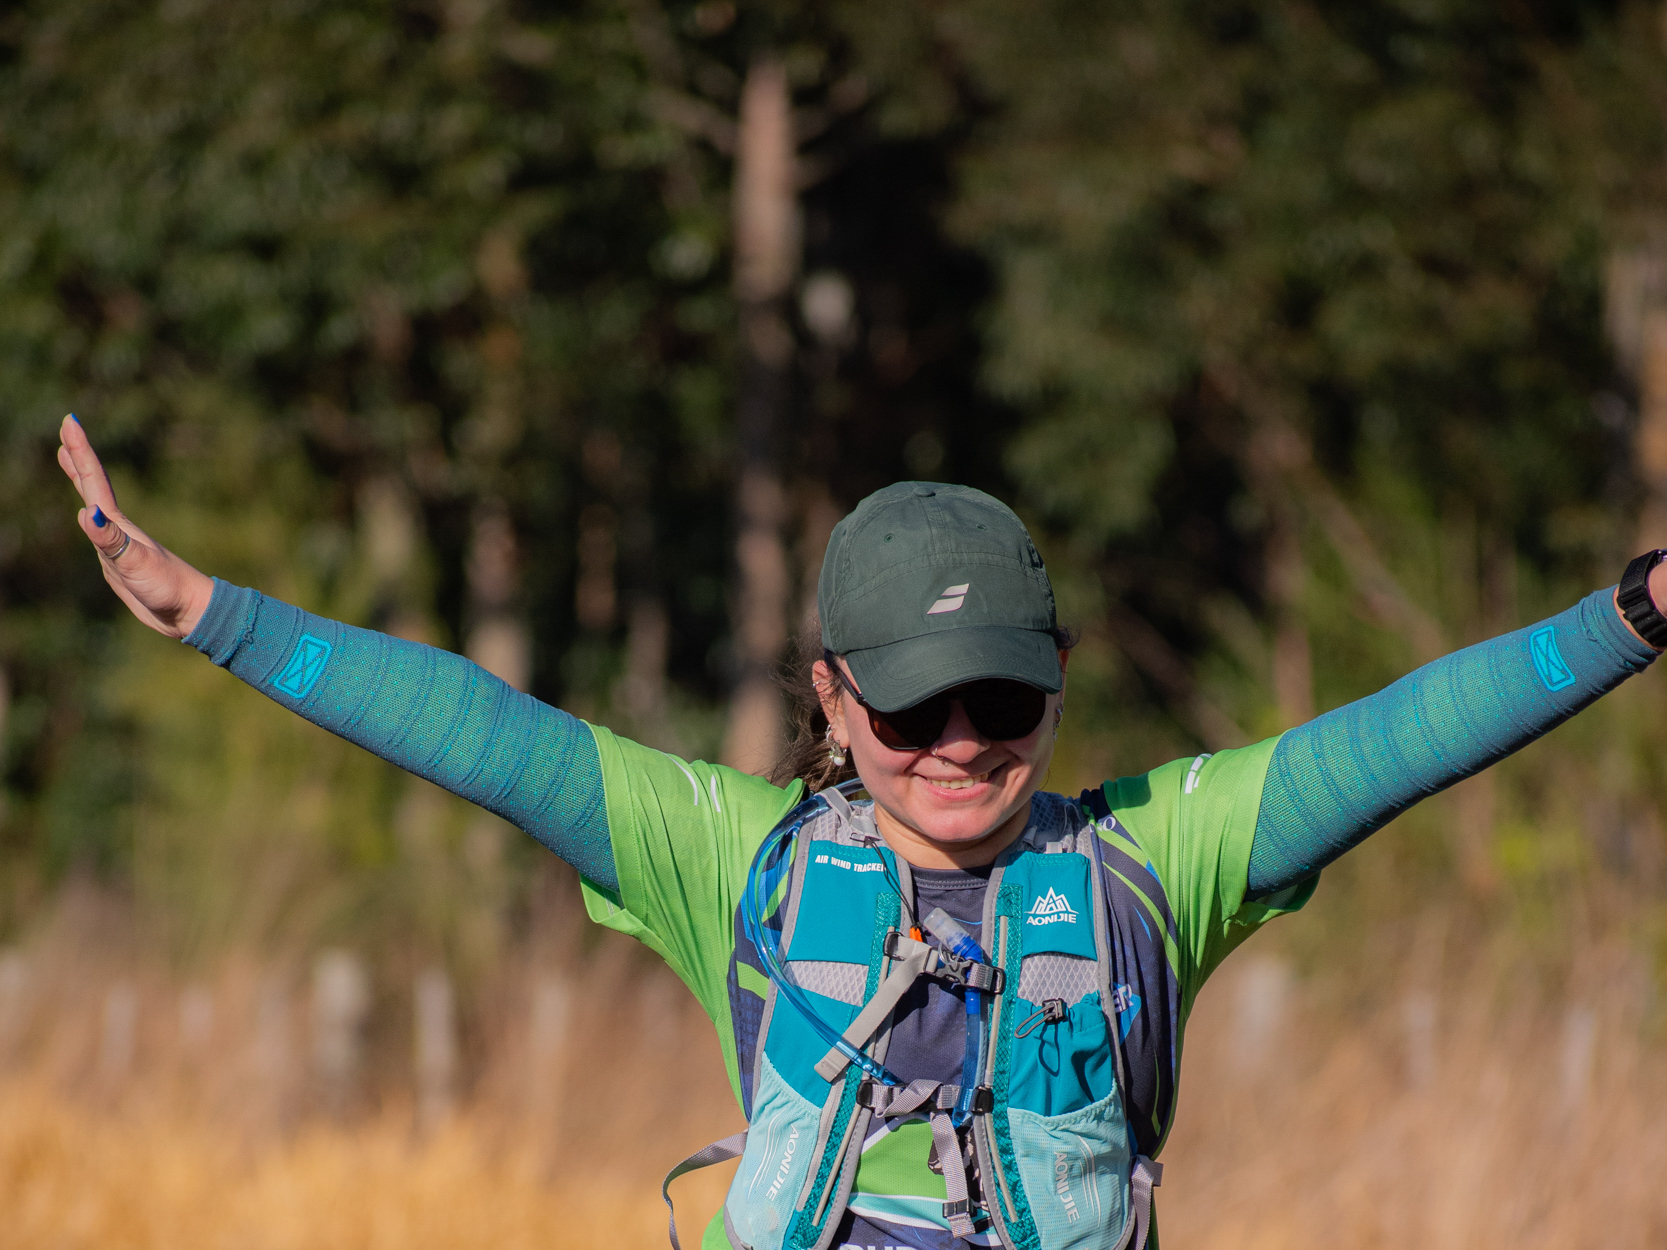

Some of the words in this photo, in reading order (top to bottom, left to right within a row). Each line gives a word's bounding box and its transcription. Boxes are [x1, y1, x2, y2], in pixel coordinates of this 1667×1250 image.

[815, 855, 829, 864] AIR
[831, 857, 851, 870] WIND
[1026, 913, 1077, 926] AONIJIE
[765, 1124, 799, 1202] AONIJIE
[1053, 1151, 1080, 1224] AONIJIE
